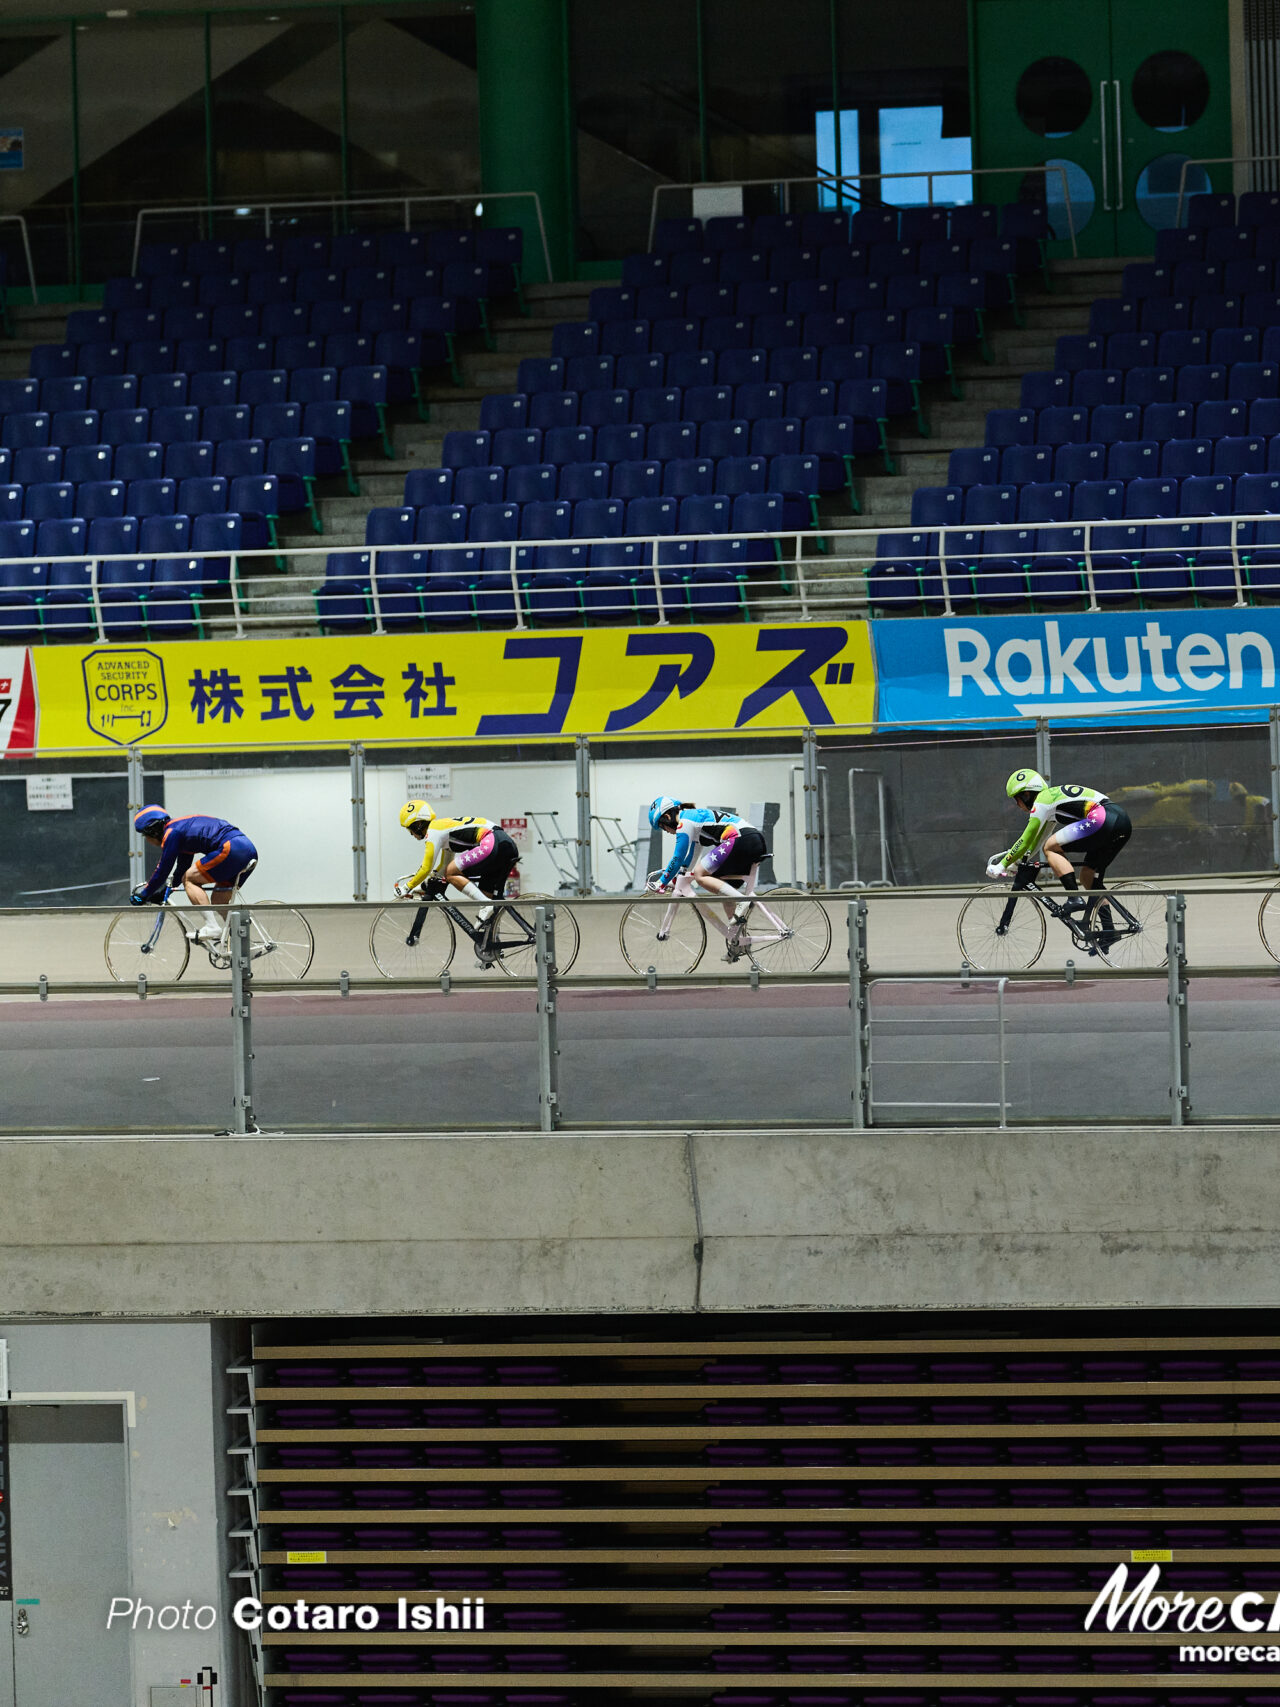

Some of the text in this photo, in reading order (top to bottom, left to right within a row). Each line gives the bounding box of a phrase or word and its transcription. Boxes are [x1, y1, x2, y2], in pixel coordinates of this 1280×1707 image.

[944, 620, 1276, 697] Rakuten
[97, 661, 150, 671] ADVANCED
[100, 671, 148, 681] SECURITY
[188, 626, 855, 737] 株式会社 コアズ
[95, 683, 158, 702] CORPS
[1016, 770, 1026, 781] 6
[407, 803, 416, 813] 5
